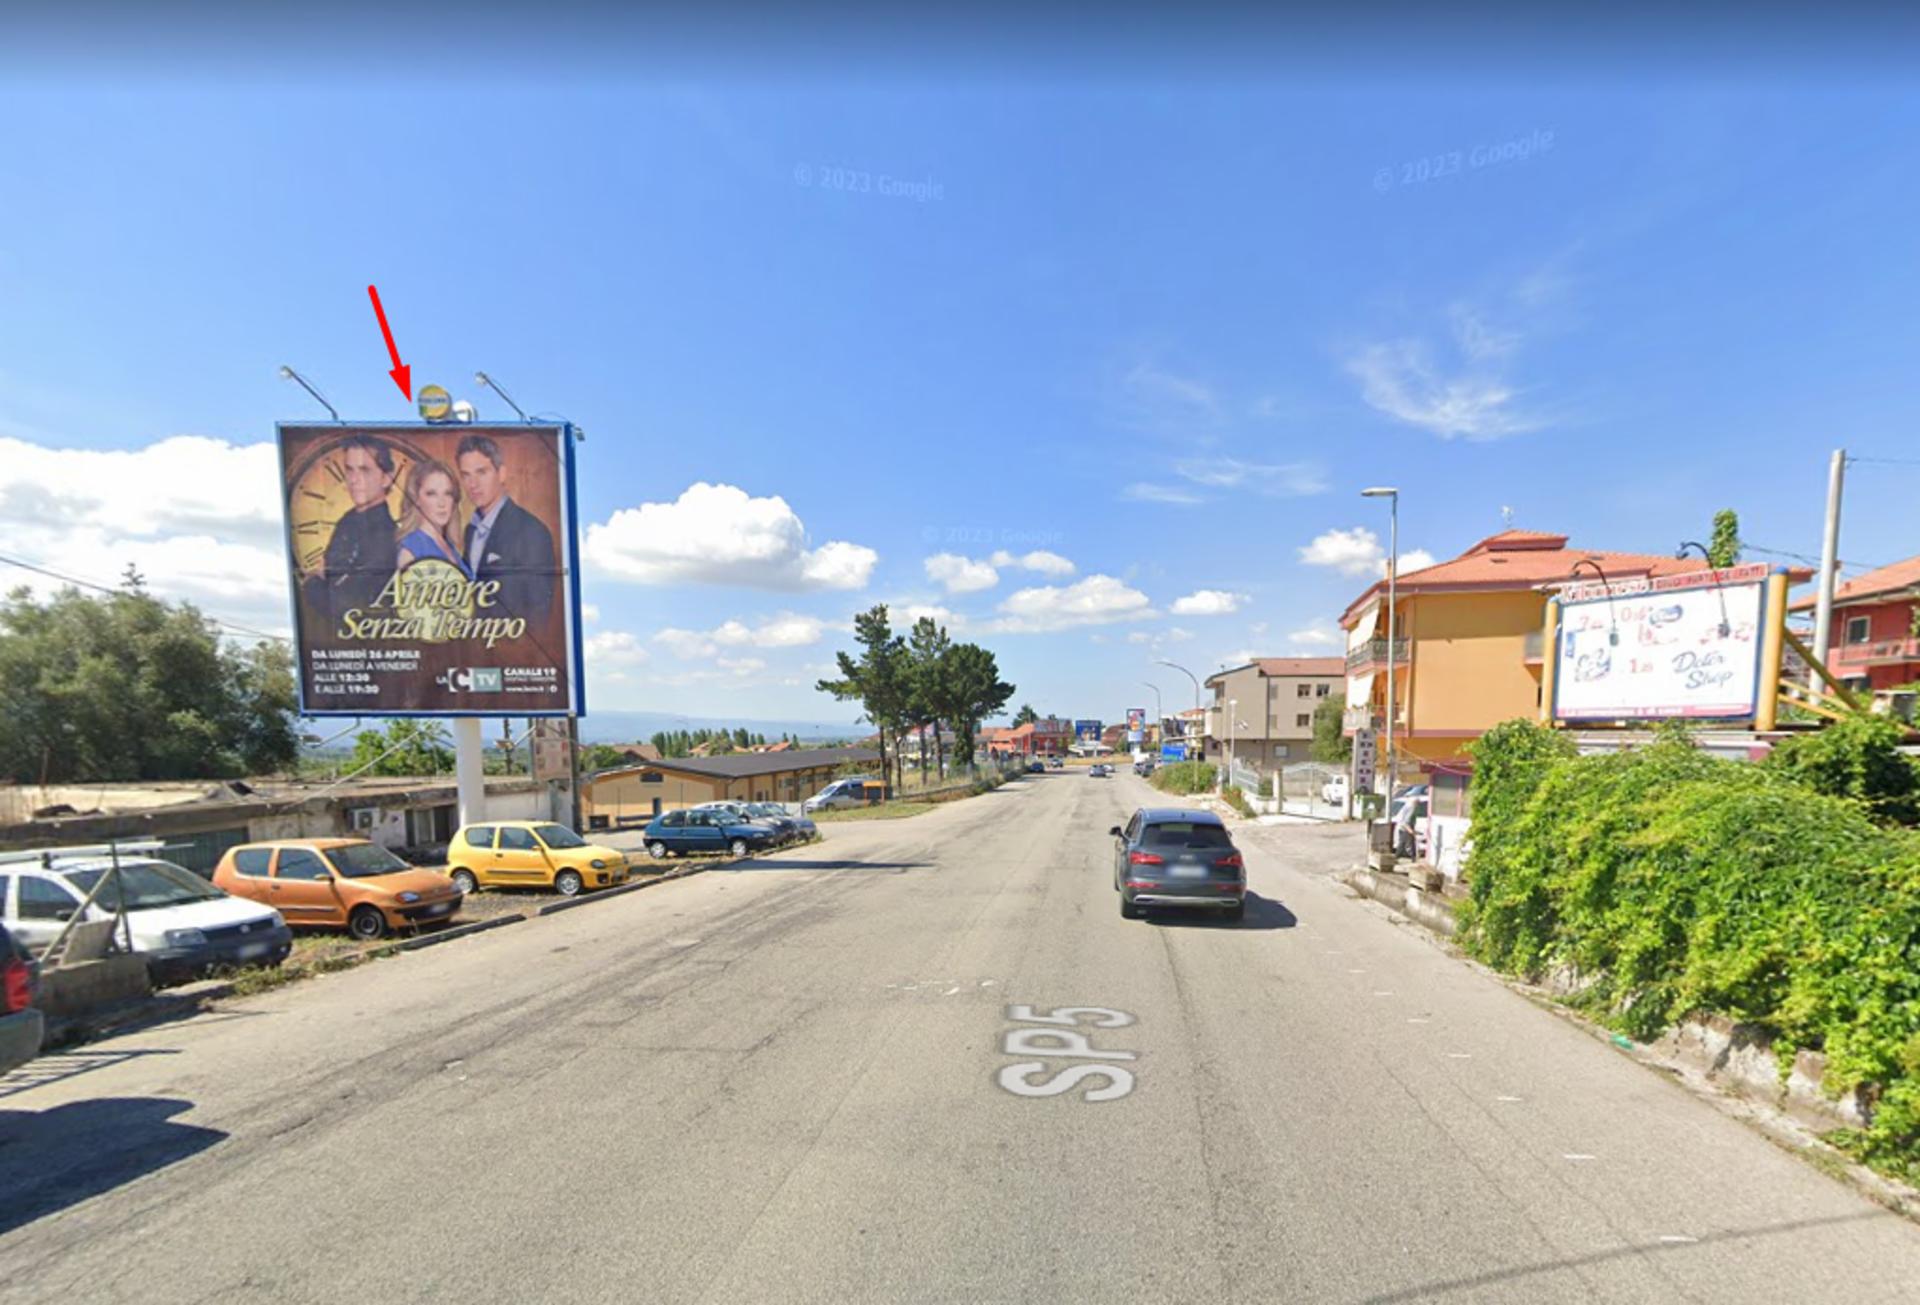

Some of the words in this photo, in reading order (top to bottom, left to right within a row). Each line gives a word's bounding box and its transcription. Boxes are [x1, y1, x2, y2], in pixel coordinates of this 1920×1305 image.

[369, 575, 501, 609] Amore
[337, 607, 424, 641] Senza
[432, 610, 527, 649] Tempo
[312, 650, 327, 659] DA
[384, 650, 421, 659] APRILE
[312, 661, 327, 671] DA
[366, 661, 374, 671] A
[503, 667, 542, 676] CANALE
[314, 673, 336, 682] ALLE
[476, 673, 498, 687] TV
[322, 684, 346, 695] ALLE
